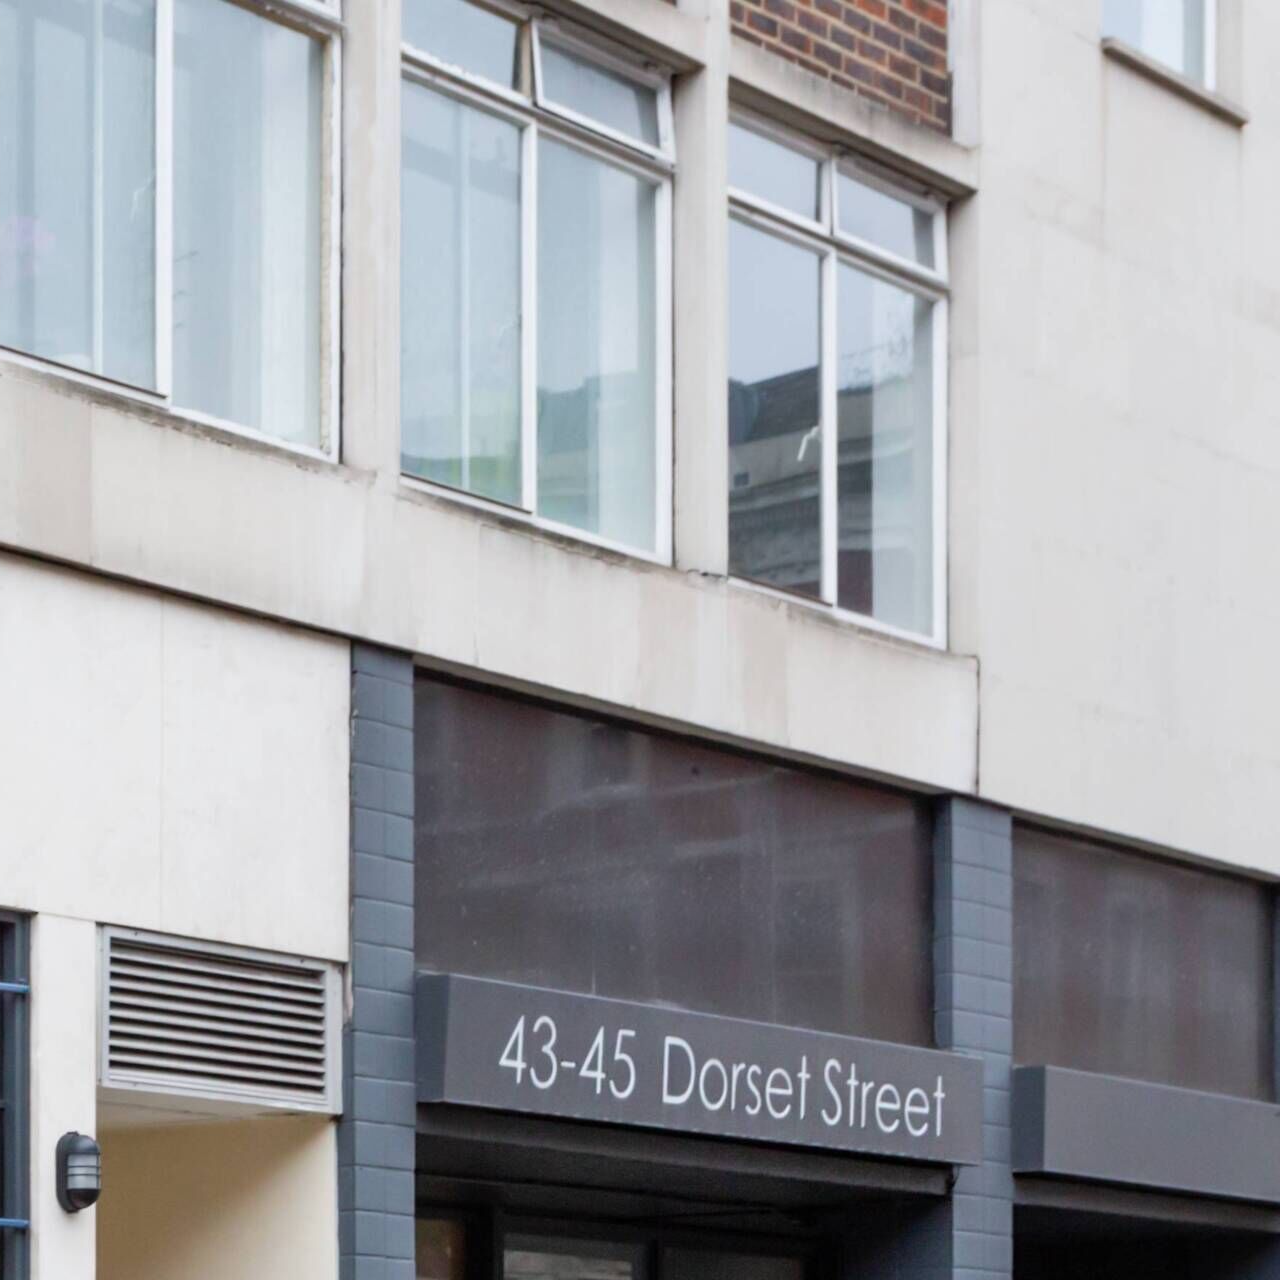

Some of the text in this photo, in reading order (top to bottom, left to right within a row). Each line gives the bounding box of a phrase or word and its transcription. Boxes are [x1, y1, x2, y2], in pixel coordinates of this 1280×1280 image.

[498, 1014, 946, 1137] 43-45 Dorset Street
